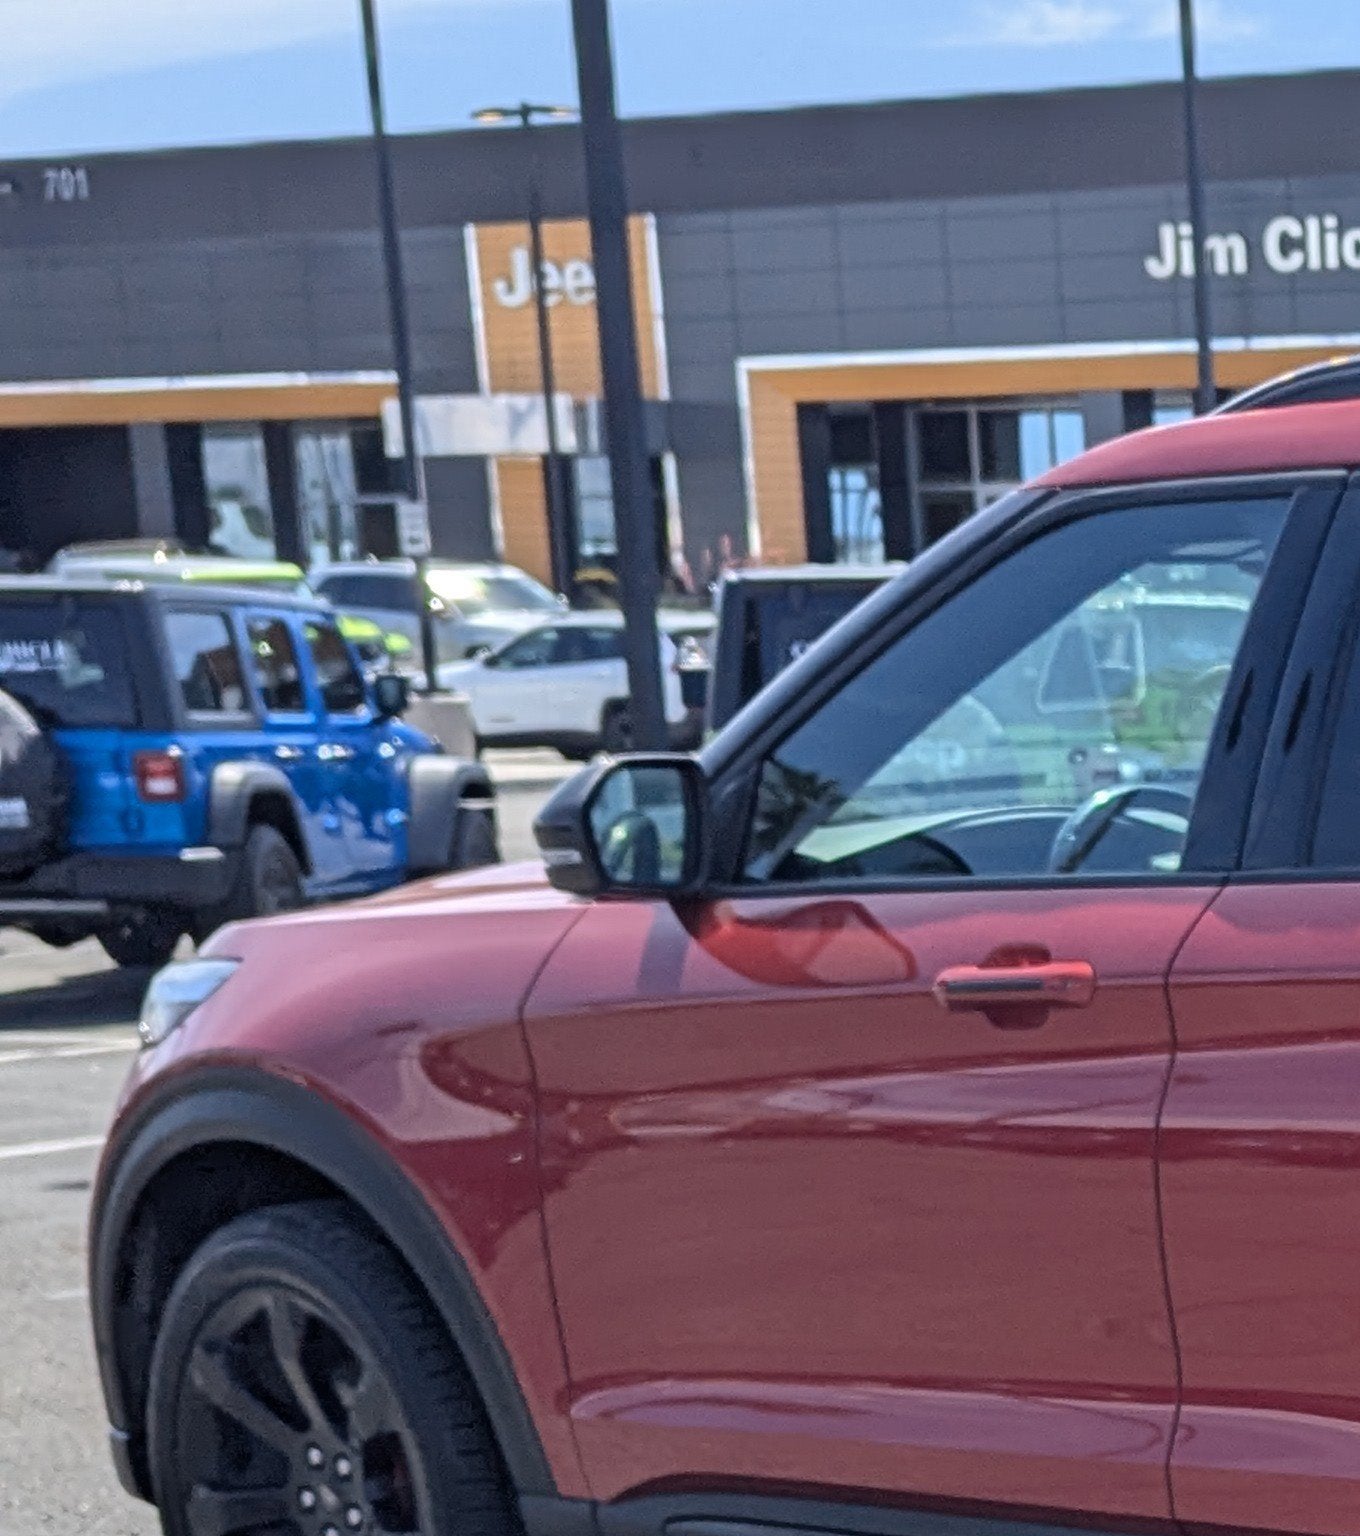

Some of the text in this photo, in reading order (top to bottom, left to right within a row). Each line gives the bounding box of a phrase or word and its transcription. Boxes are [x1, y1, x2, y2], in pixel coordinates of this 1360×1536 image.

[44, 167, 89, 201] 701
[493, 246, 598, 308] Jee
[1144, 221, 1248, 280] Jim
